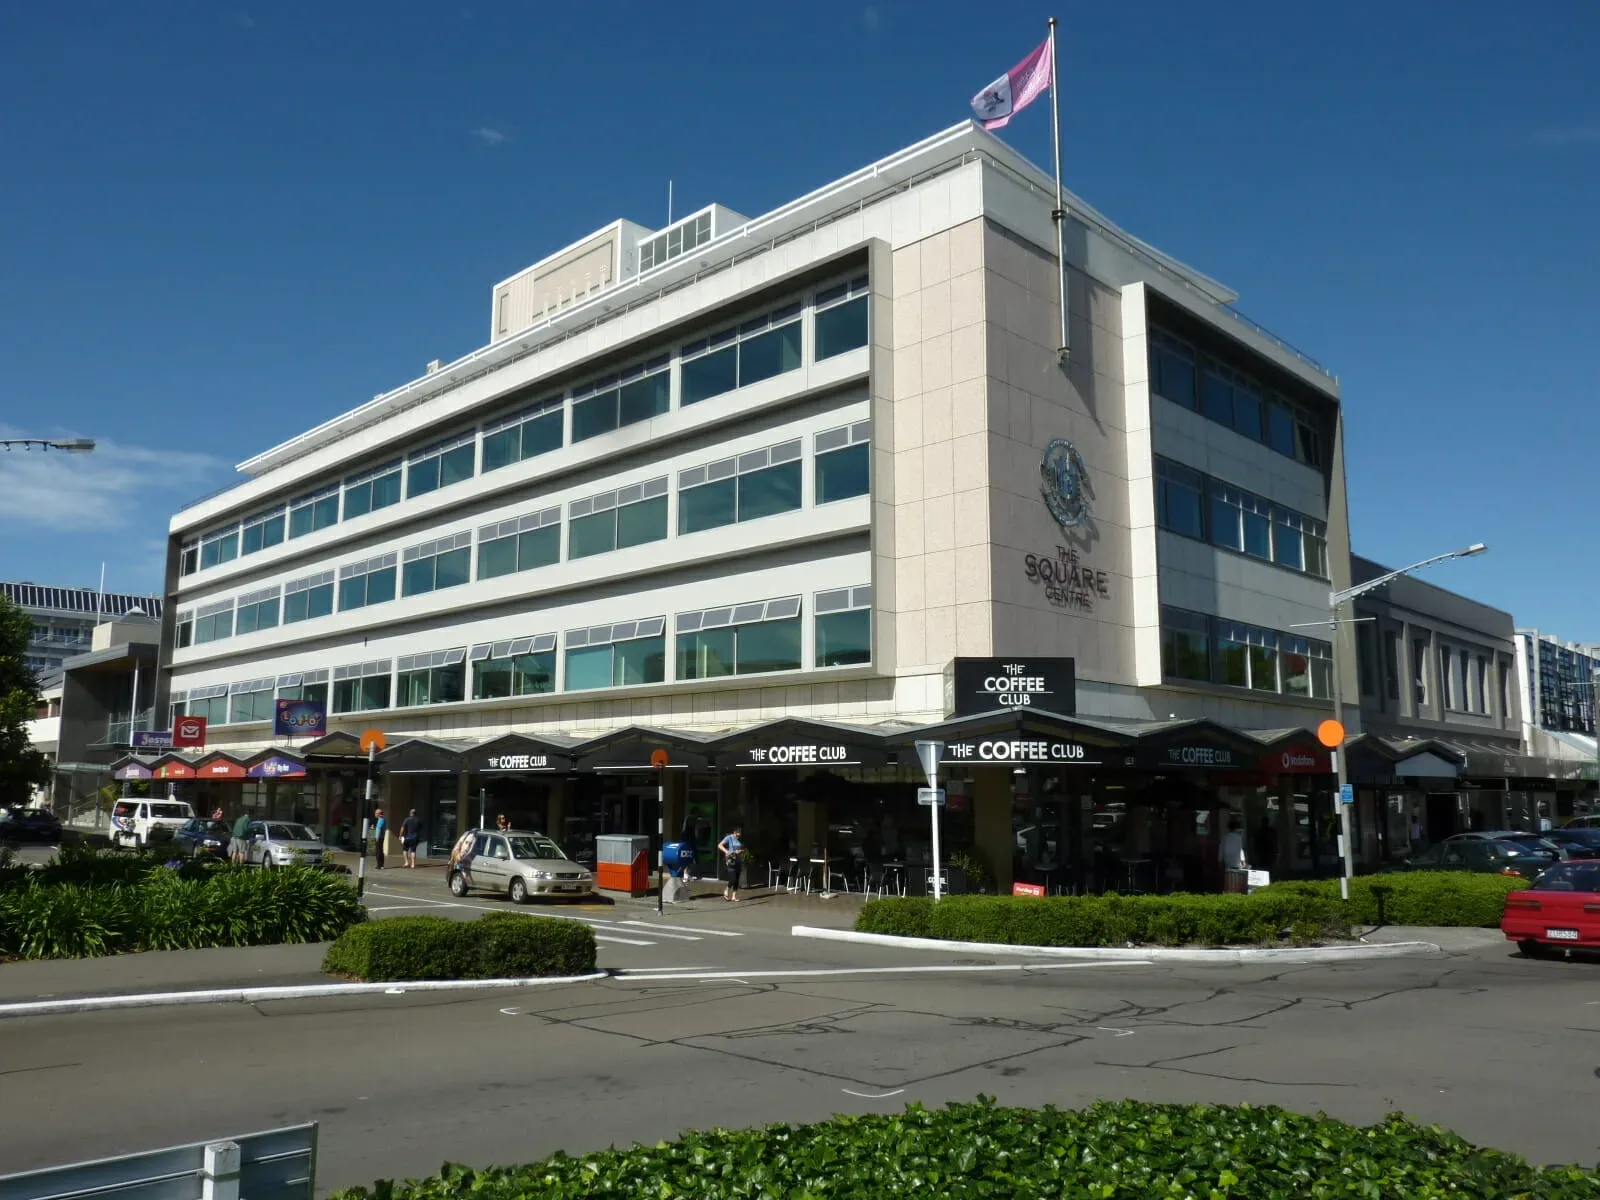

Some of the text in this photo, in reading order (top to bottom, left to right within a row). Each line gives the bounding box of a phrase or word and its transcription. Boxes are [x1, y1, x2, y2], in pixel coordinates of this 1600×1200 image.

[1055, 545, 1078, 562] THE
[1024, 554, 1107, 593] SQUARE
[1044, 587, 1090, 606] CENTRE
[1002, 663, 1025, 676] THE
[984, 676, 1045, 692] COFFEE
[998, 693, 1031, 705] CLUB
[749, 745, 847, 763] THE COFFEE CLUB
[947, 741, 1085, 760] THE COFFEE CLUB
[1182, 746, 1214, 764] COFFEE
[1214, 749, 1231, 763] CLUB
[487, 755, 547, 769] THE COFFEE CLUB
